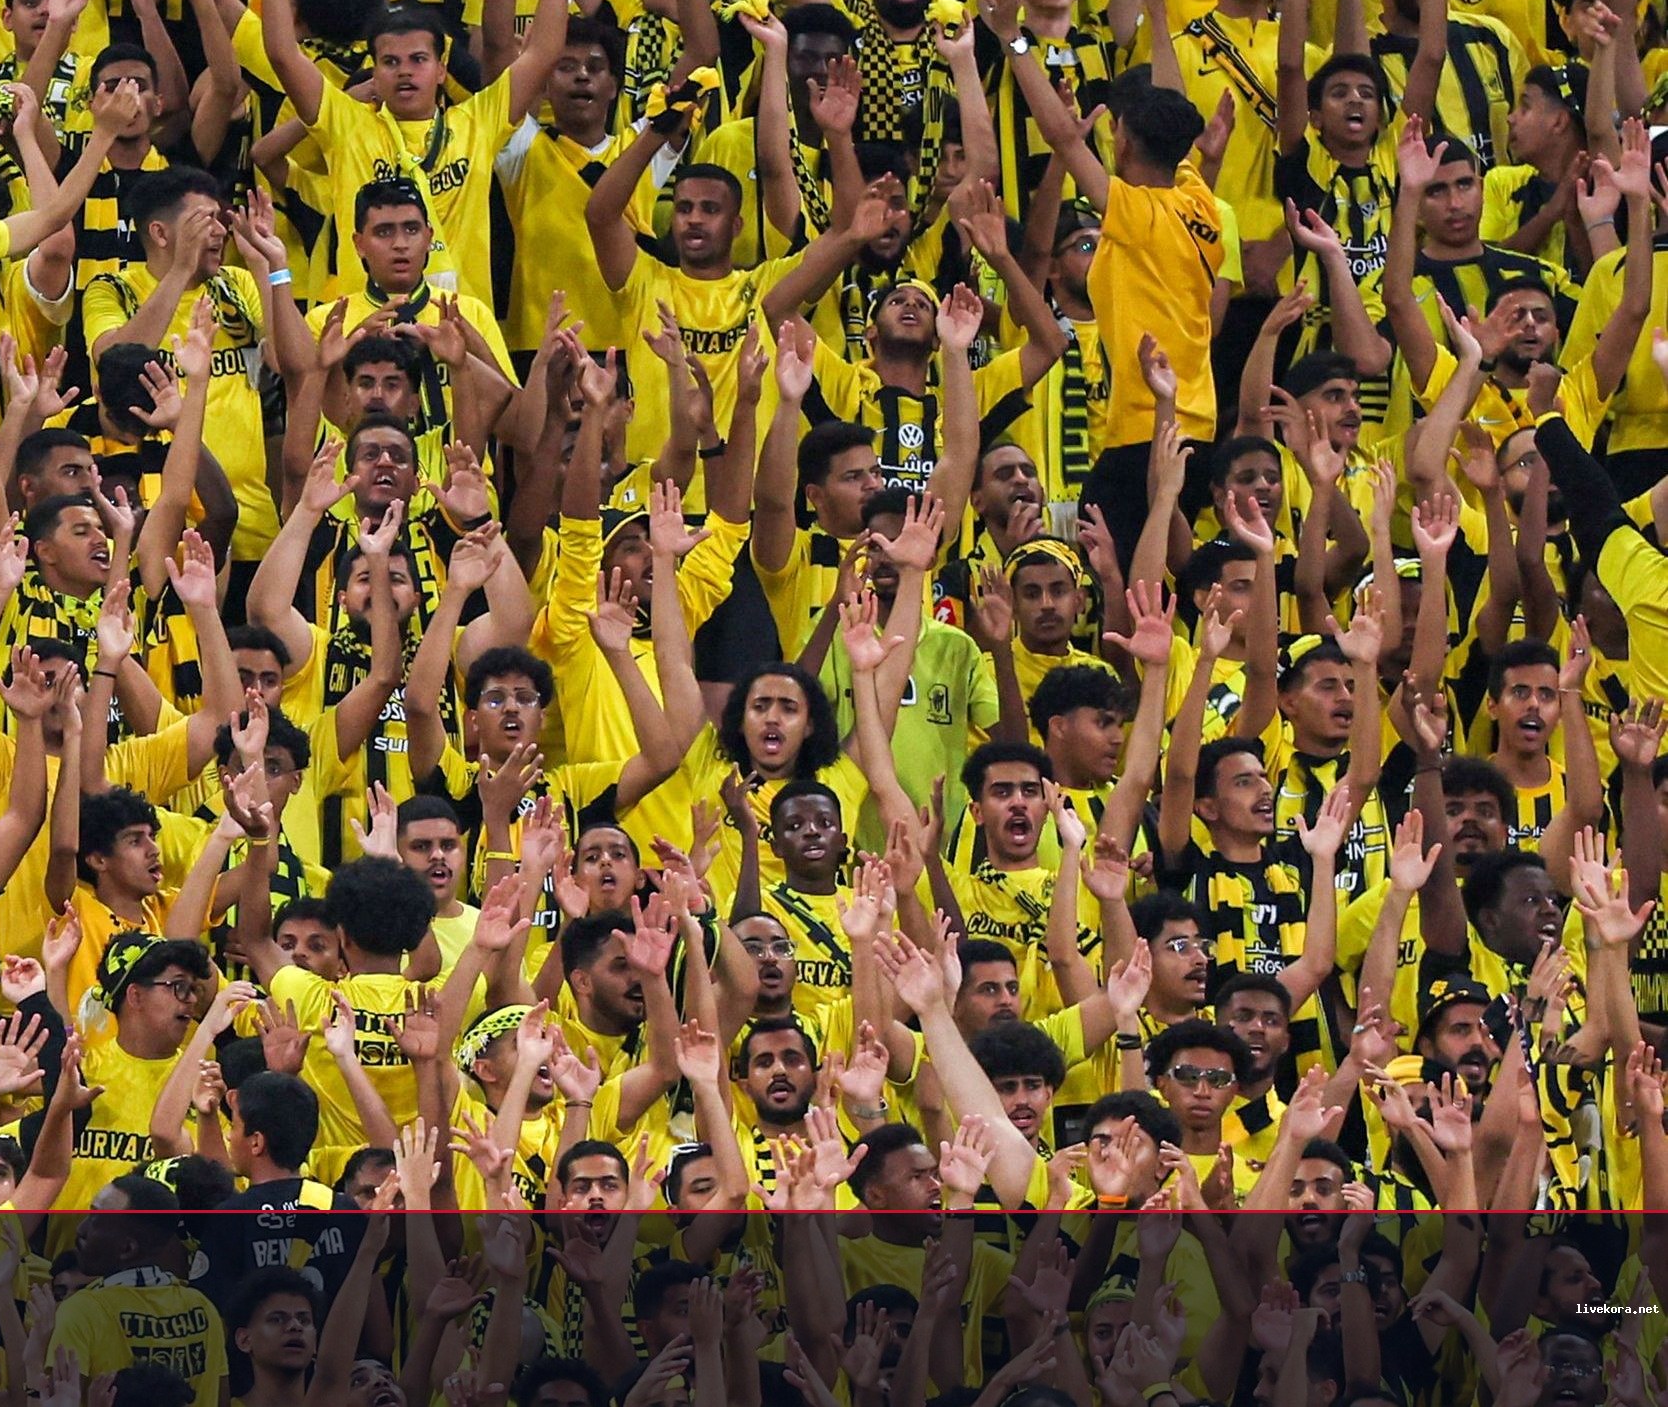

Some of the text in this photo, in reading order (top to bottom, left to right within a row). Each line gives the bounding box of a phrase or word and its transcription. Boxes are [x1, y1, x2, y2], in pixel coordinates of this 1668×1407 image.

[683, 330, 721, 355] RVA
[210, 349, 247, 378] GOL
[798, 962, 842, 986] URVA
[1254, 960, 1283, 974] ROS
[252, 1227, 345, 1269] BENMA
